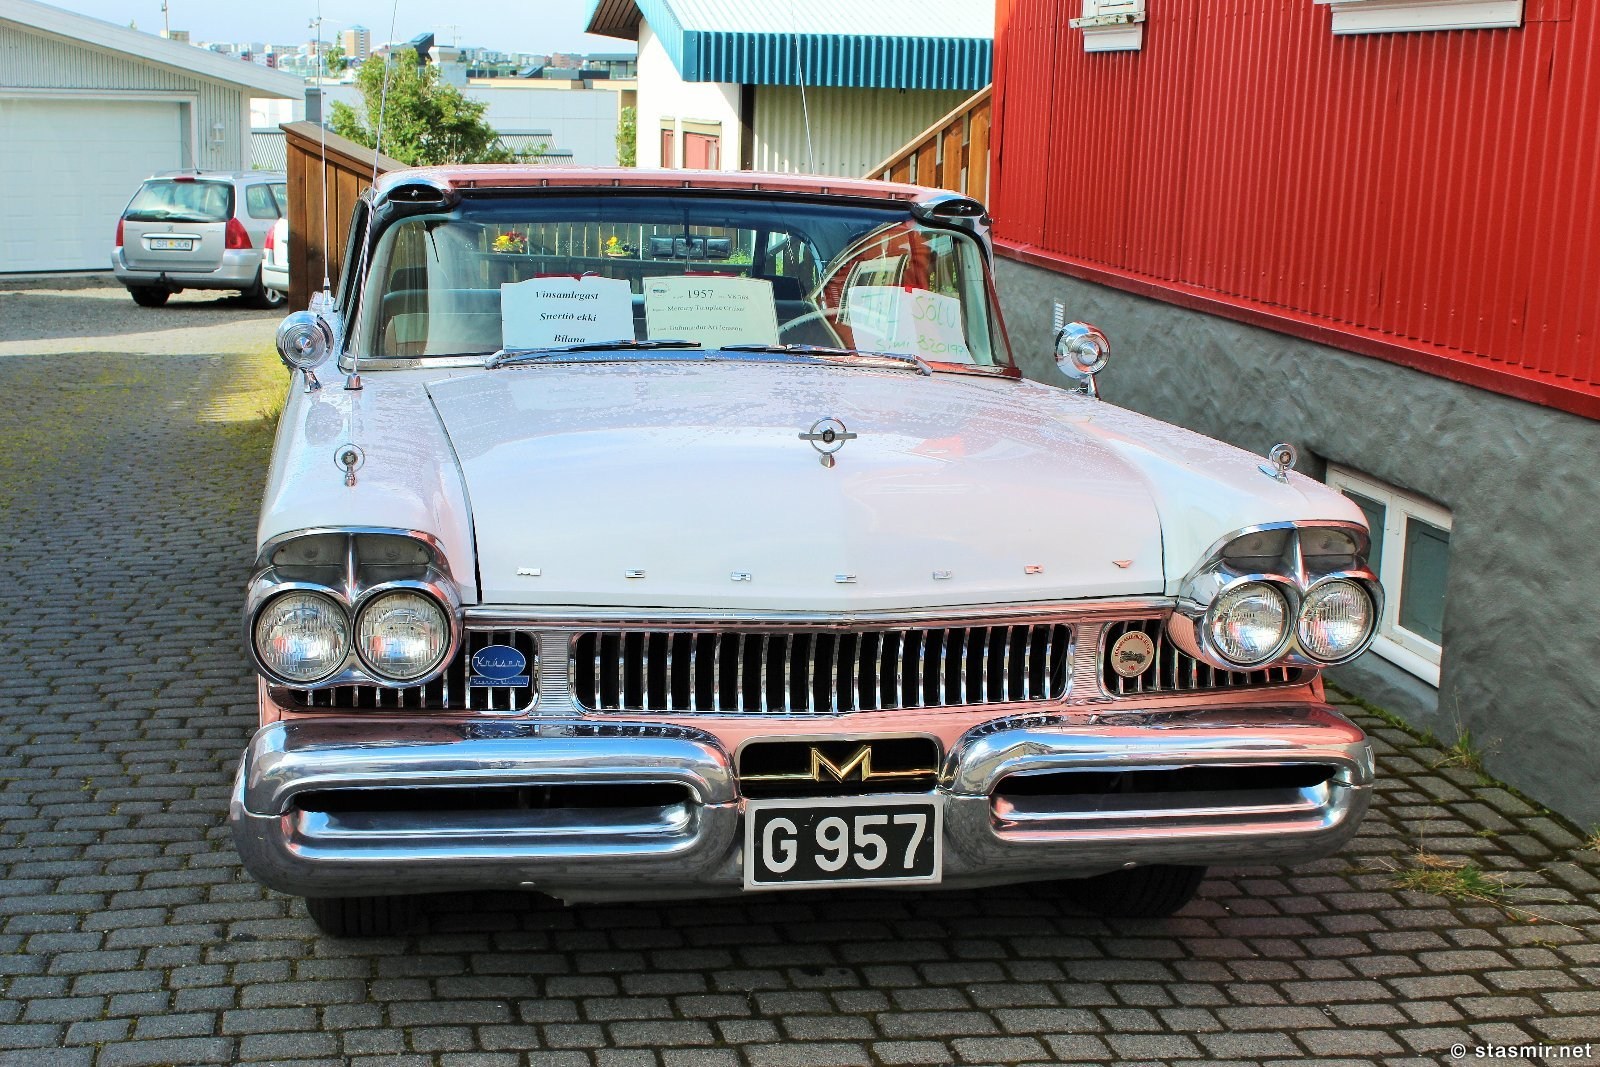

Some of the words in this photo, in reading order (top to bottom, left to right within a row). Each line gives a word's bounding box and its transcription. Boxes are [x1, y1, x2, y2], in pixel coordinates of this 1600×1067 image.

[535, 290, 600, 301] Vinsamlegast
[687, 289, 714, 299] 1957
[576, 312, 597, 322] ekki
[762, 817, 798, 873] G
[814, 813, 927, 872] 957
